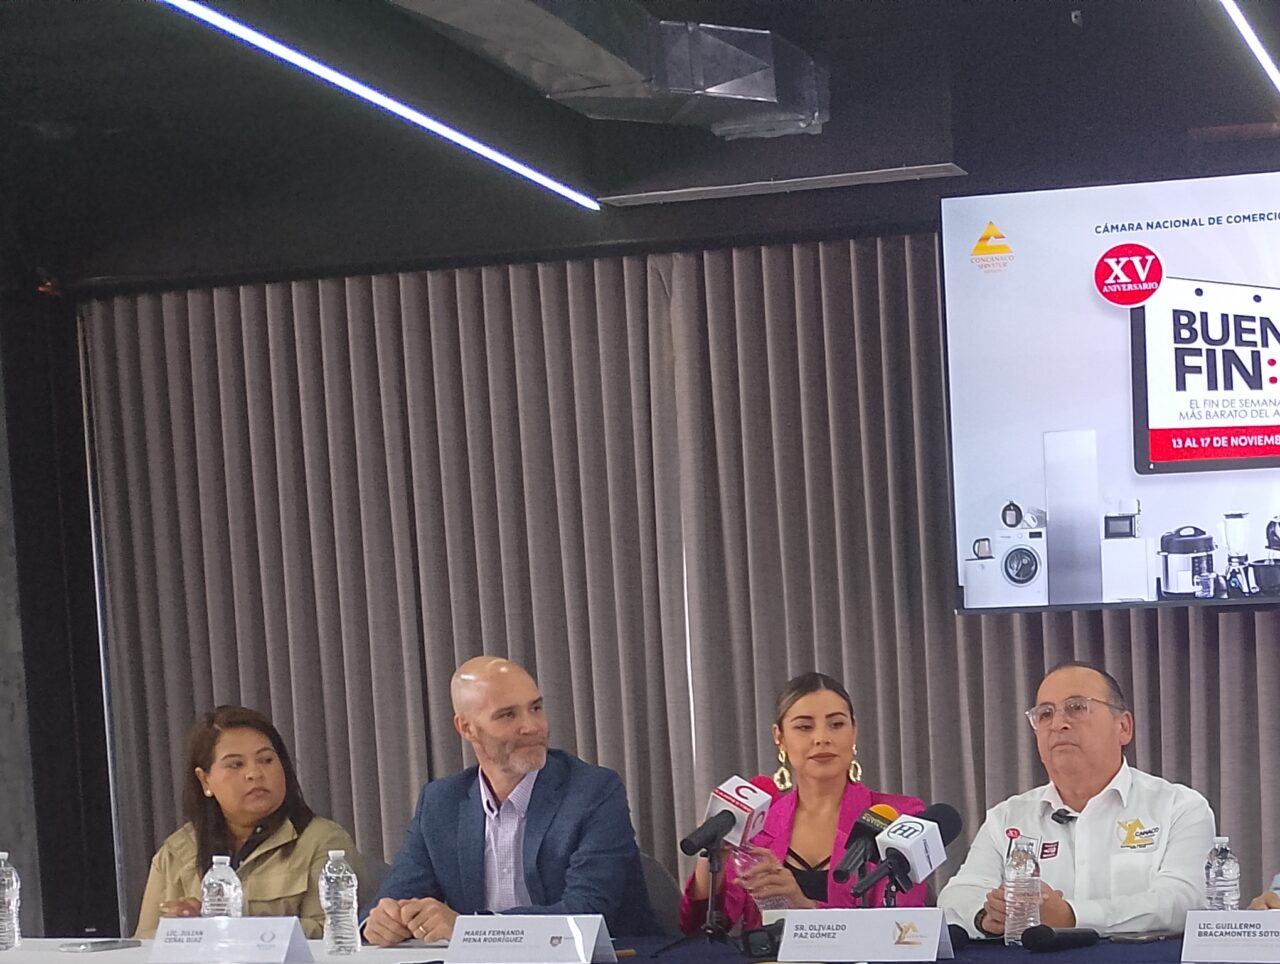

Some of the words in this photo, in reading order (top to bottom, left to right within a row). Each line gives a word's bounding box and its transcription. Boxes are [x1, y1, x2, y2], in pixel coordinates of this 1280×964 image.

[1095, 221, 1143, 234] CÁMARA
[1146, 217, 1205, 231] NACIONAL
[1208, 216, 1223, 225] DE
[1103, 255, 1156, 284] XV
[1103, 281, 1159, 293] ANIVERSARIO
[1189, 399, 1200, 409] EL
[1203, 399, 1219, 409] FIN
[1222, 399, 1237, 408] DE
[1179, 409, 1203, 421] MÁS
[1205, 410, 1248, 420] BARATO
[1251, 409, 1270, 419] DEL
[1171, 438, 1183, 449] 13
[1185, 437, 1199, 448] AL
[1200, 437, 1211, 447] 17
[1213, 436, 1228, 447] DE
[1215, 922, 1262, 930] GUILLERMO
[1197, 930, 1257, 938] BRACAMONTES
[1258, 930, 1280, 938] SOTO
